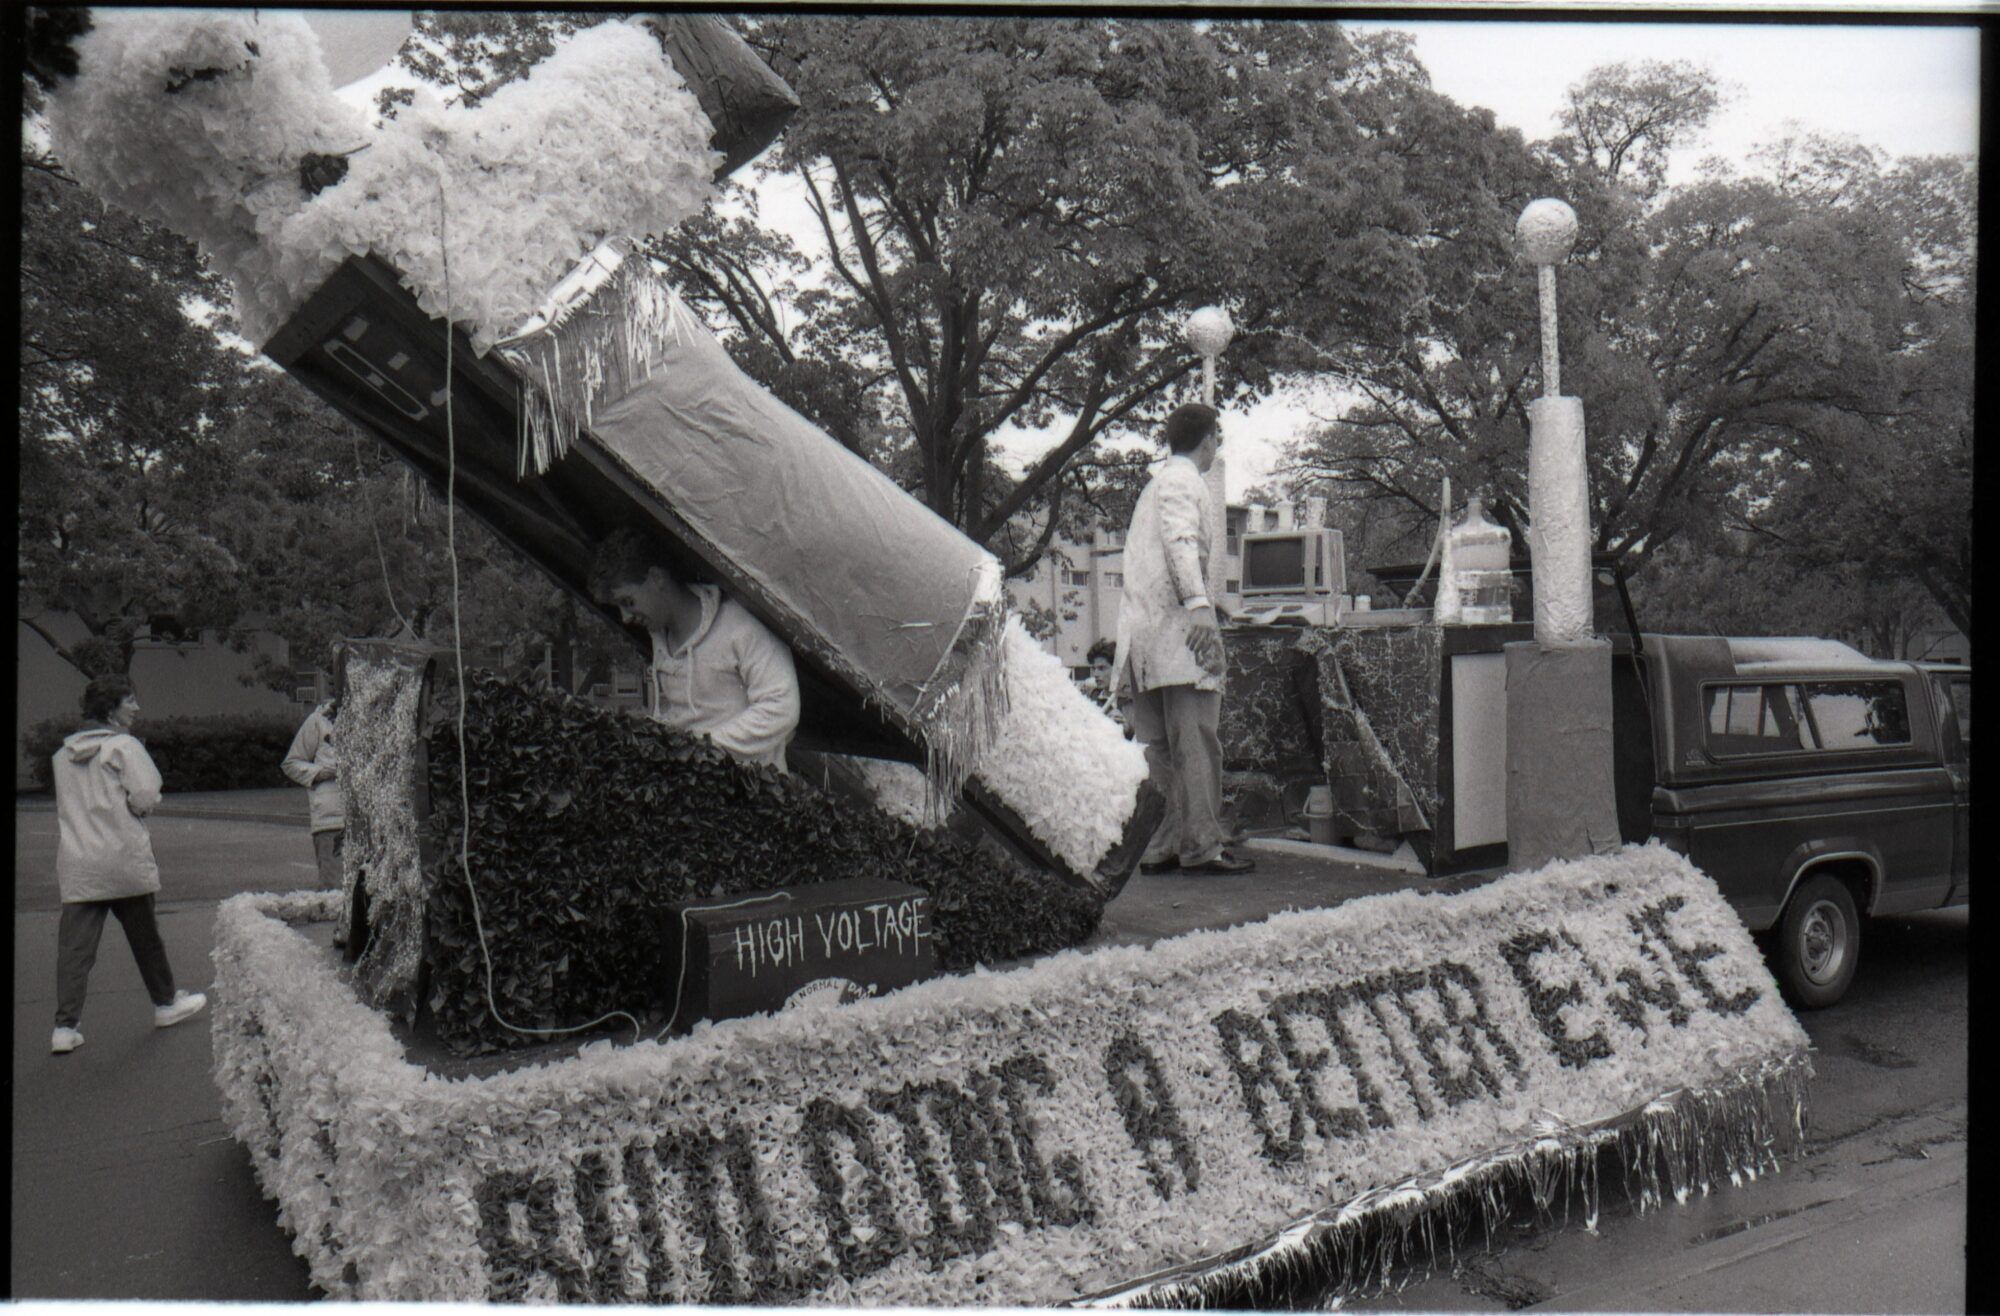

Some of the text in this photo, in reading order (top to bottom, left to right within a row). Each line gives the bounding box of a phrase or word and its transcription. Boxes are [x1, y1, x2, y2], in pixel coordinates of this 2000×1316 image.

[733, 898, 931, 978] HIGH VOLTAGE
[798, 981, 840, 999] NORMAL
[1106, 1028, 1200, 1200] A
[1212, 959, 1528, 1168] BETTER
